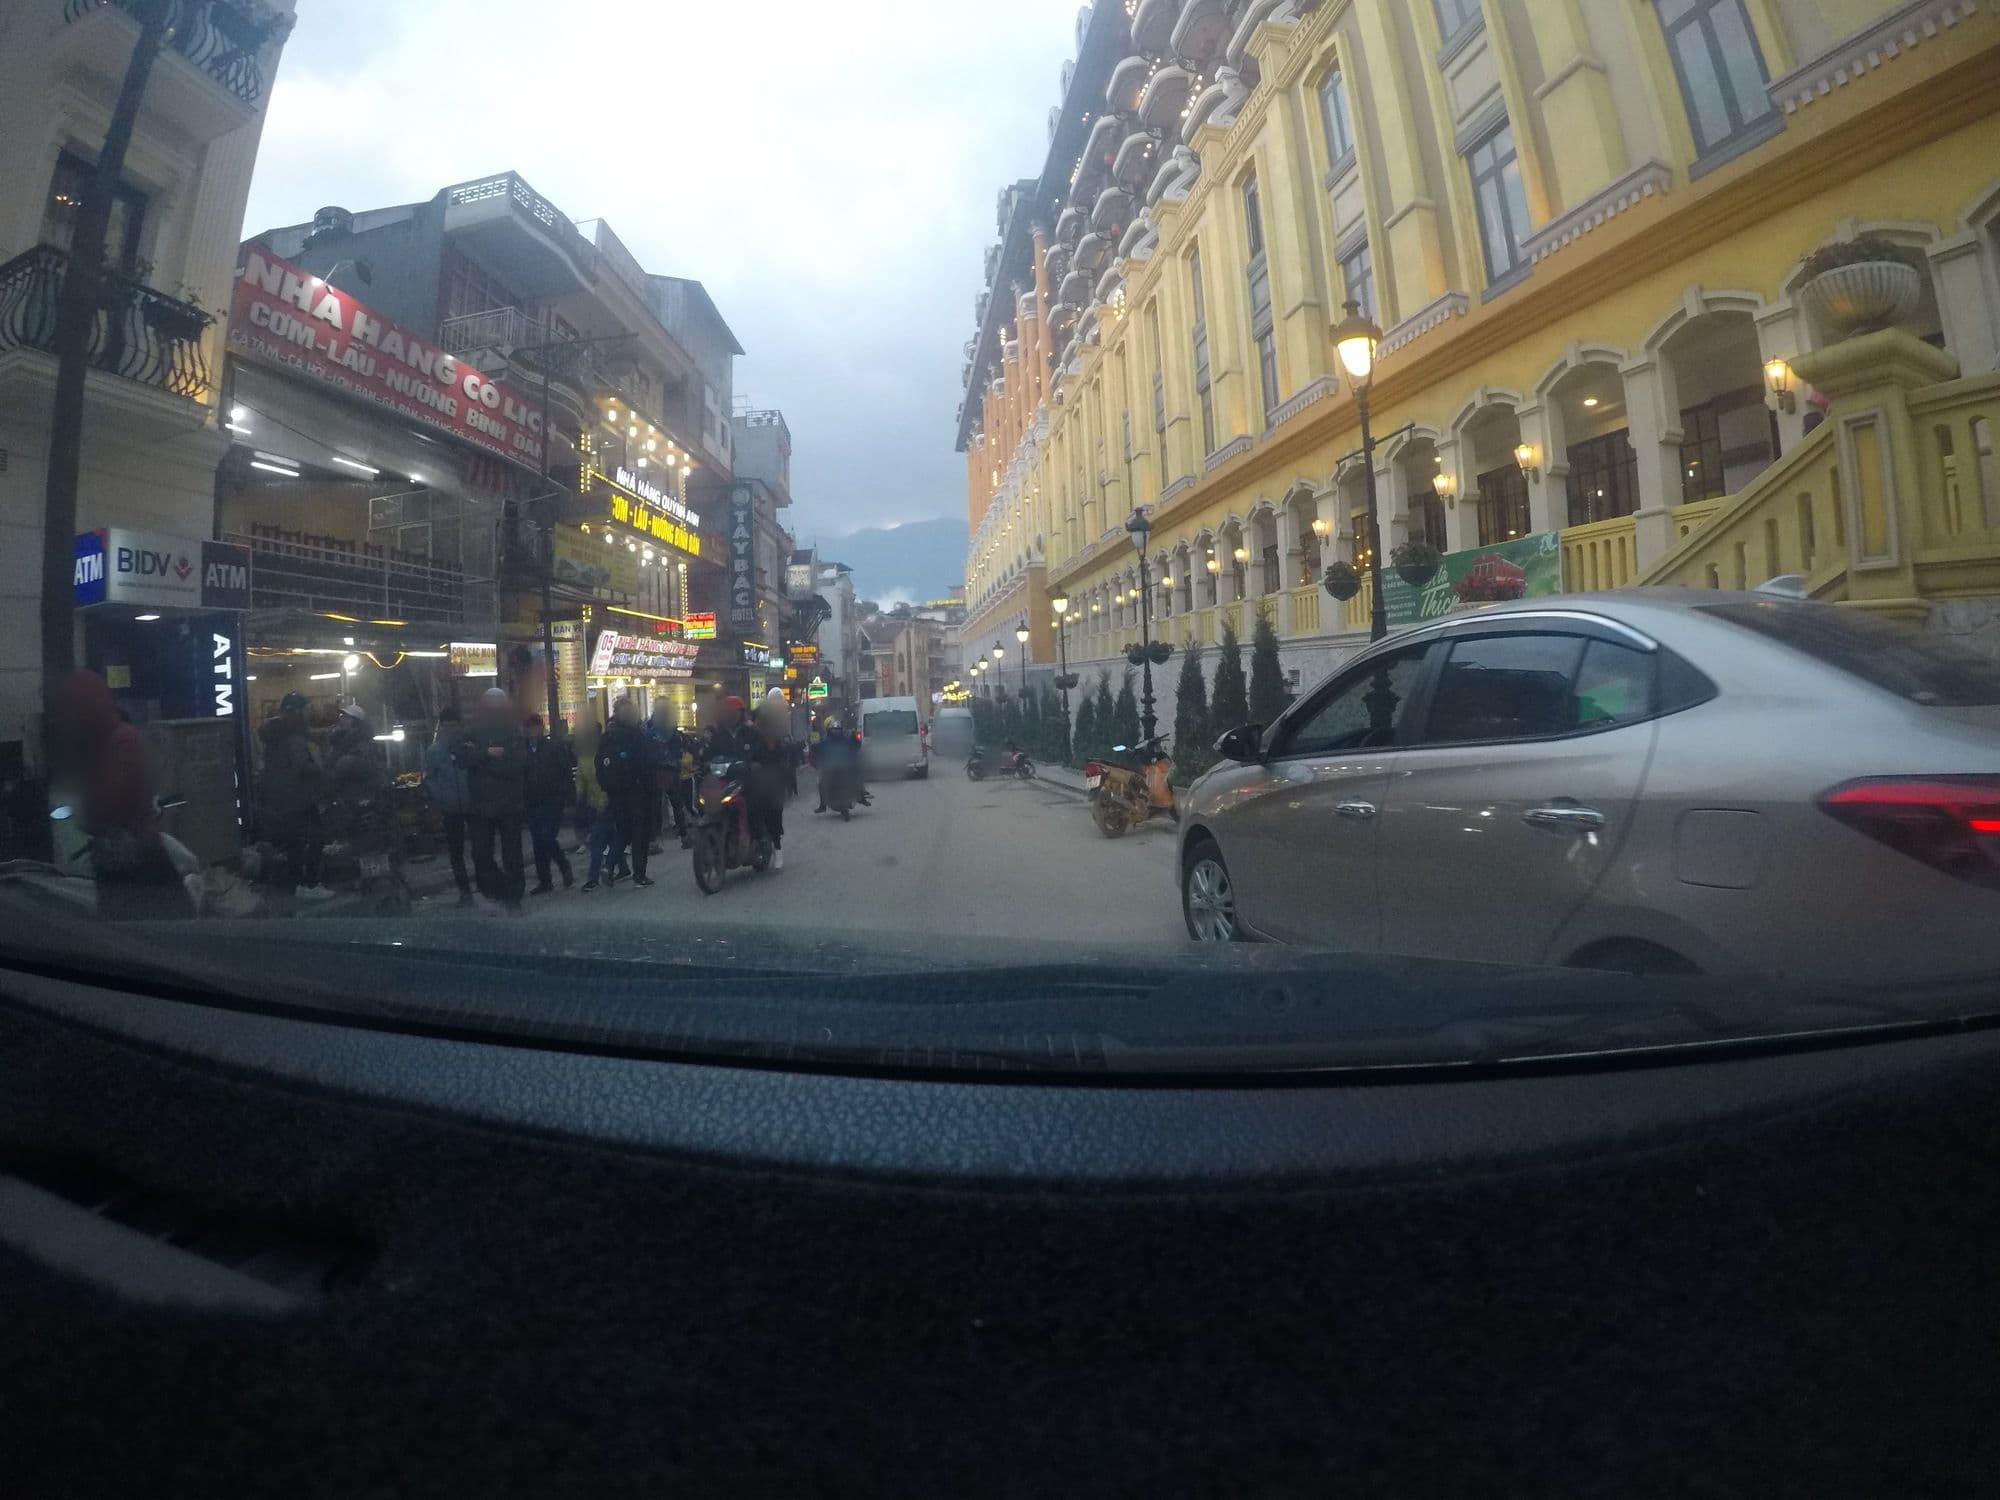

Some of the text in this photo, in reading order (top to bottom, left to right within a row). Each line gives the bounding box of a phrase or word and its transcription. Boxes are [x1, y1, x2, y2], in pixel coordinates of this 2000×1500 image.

[245, 252, 343, 330] NHÀ
[351, 310, 457, 385] HÀNG
[250, 301, 316, 352] CƠM
[616, 466, 636, 492] NHÀ
[638, 479, 661, 508] HÀNG
[73, 552, 104, 585] ATM
[117, 547, 171, 577] BIDV
[206, 563, 247, 590] ATM
[601, 634, 613, 652] 05
[212, 633, 233, 717] ATM
